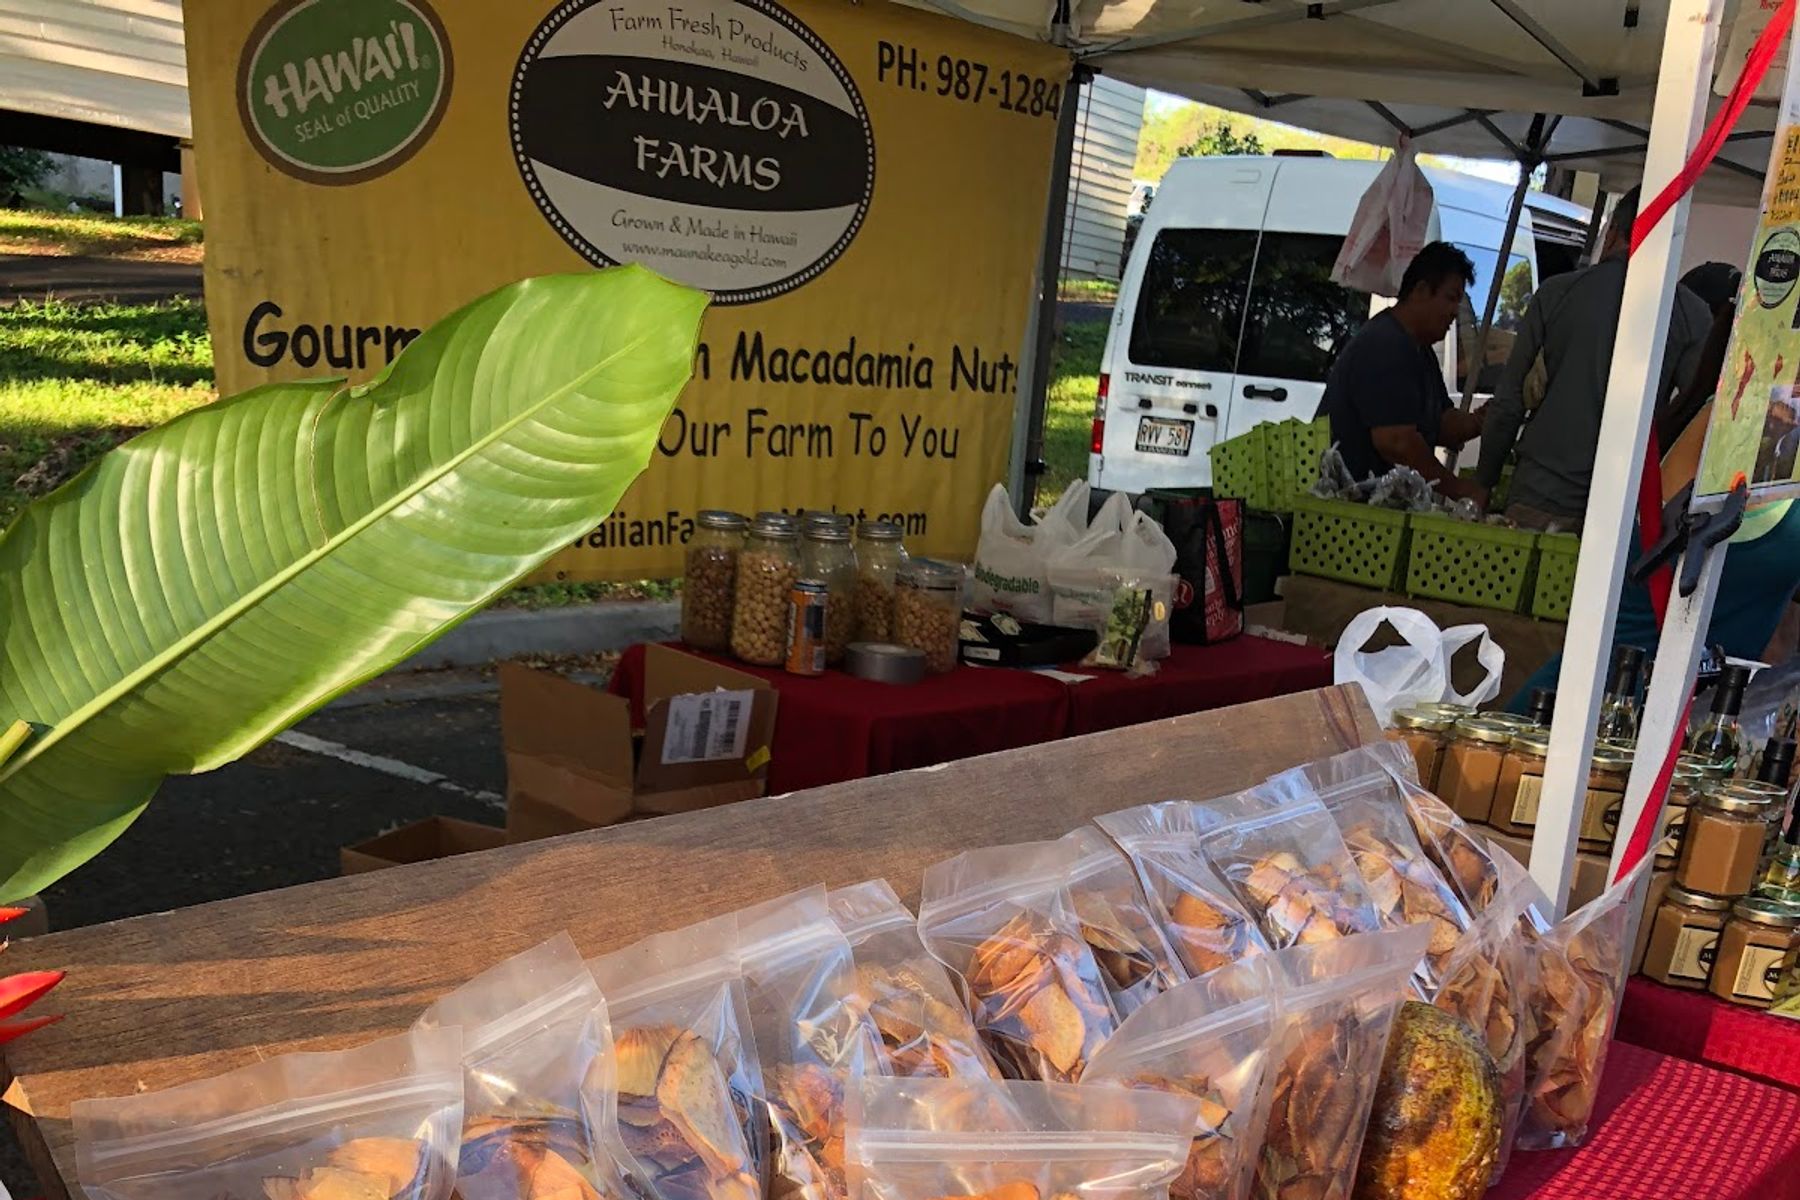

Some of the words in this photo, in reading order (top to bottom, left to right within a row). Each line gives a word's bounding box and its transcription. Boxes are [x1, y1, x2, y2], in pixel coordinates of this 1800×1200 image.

[608, 7, 662, 32] Farm
[667, 7, 722, 40] Fresh
[727, 18, 810, 72] Products
[603, 70, 809, 139] AHUALOA
[877, 40, 927, 91] PH:
[936, 55, 1061, 121] 987-1284
[294, 115, 334, 143] SEAL
[335, 105, 352, 128] of
[353, 79, 420, 121] QUALITY
[633, 135, 782, 192] FARMS
[611, 209, 665, 232] Grown
[669, 216, 682, 234] &
[686, 217, 729, 239] Made
[734, 225, 746, 241] in
[749, 224, 798, 248] Hawaii
[730, 331, 934, 389] Macadamia
[1125, 372, 1175, 387] TRANSIT
[658, 408, 732, 458] Our
[746, 408, 833, 459] Farm
[848, 411, 887, 458] To
[900, 413, 960, 459] You
